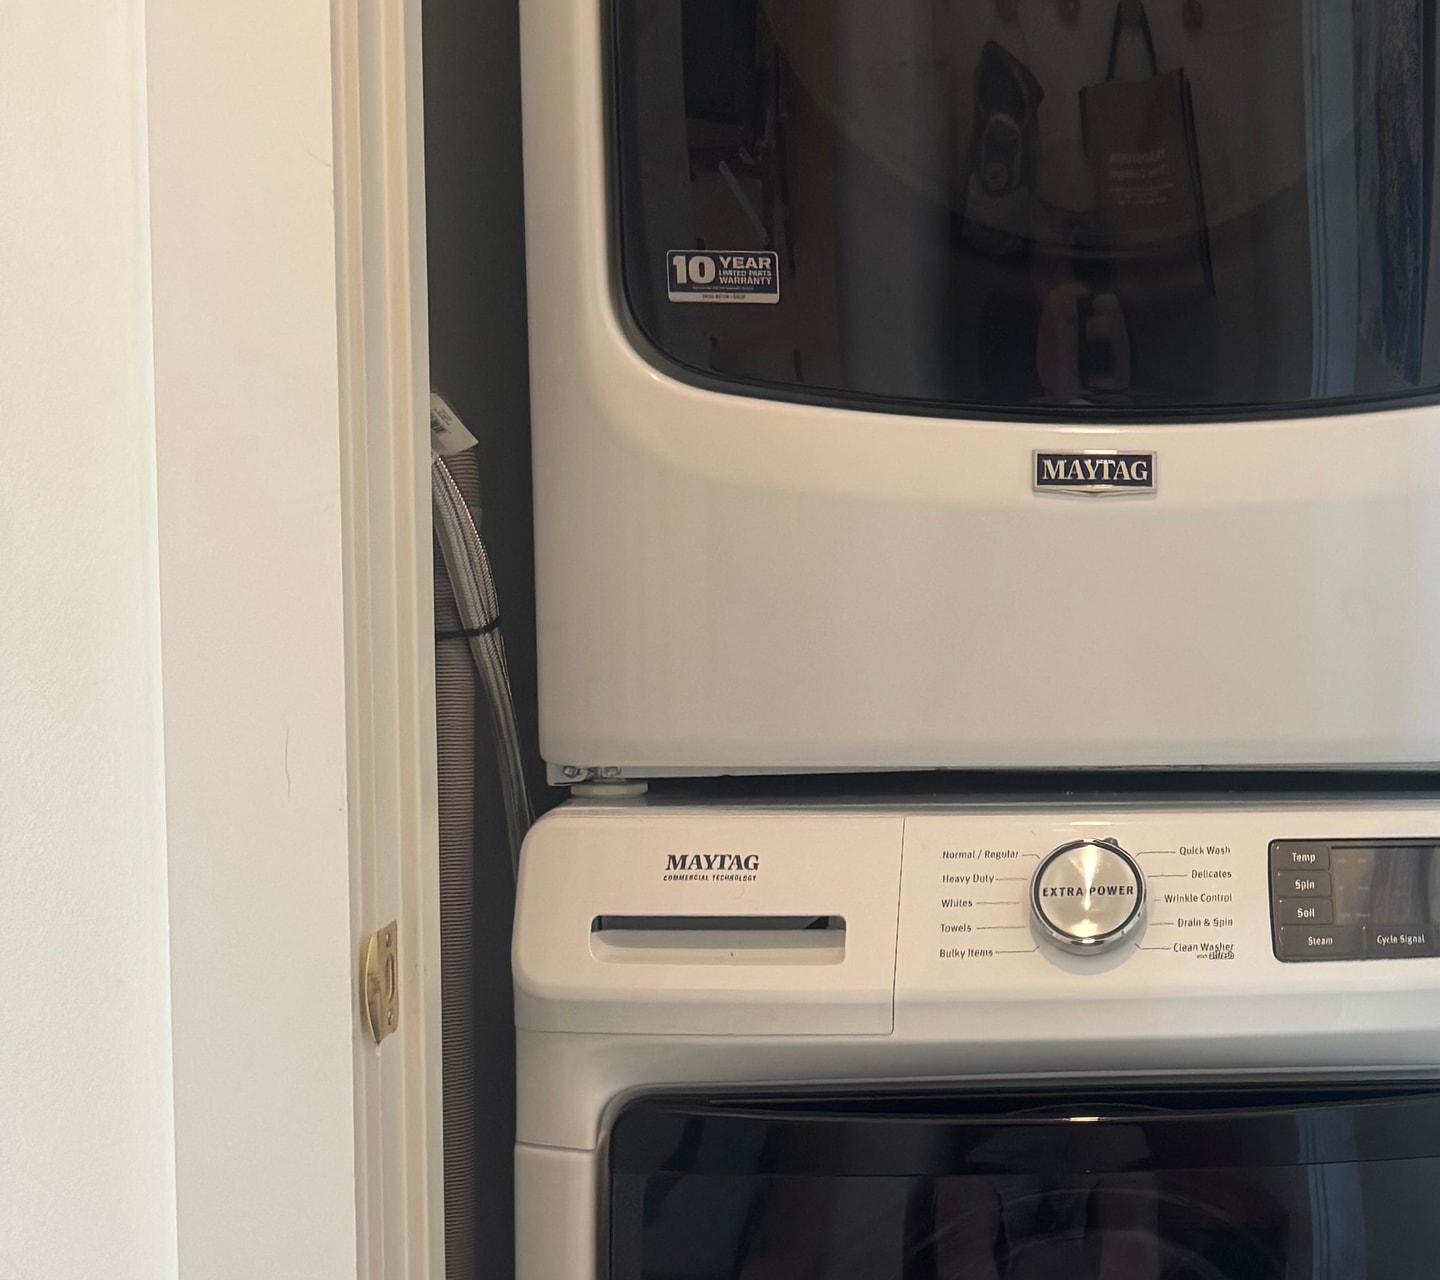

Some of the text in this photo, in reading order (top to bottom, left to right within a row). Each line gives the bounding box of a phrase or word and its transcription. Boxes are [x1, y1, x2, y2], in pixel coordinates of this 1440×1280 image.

[673, 255, 771, 284] 10 YEAR
[719, 276, 772, 285] WARRANTY
[1042, 459, 1149, 481] MAYTAG
[942, 849, 975, 860] Normal
[984, 849, 1019, 860] Regular
[1179, 845, 1231, 856] Quick Wash
[665, 853, 760, 871] MAYTAG
[1292, 852, 1316, 863] Temp
[663, 874, 757, 882] COMMERCIAL TECHNOLOGY
[942, 874, 995, 885] Heavy Duty
[1191, 869, 1232, 879] Delicates
[1295, 879, 1315, 891] Spin
[1042, 885, 1134, 897] EXTRA POWER
[941, 898, 973, 908] Whites
[1164, 893, 1232, 903] Wrinkle Control
[1297, 907, 1315, 918] Soil
[940, 923, 972, 933] Towels
[1177, 917, 1233, 928] Drain & Spin
[1308, 935, 1333, 945] Steam
[1377, 934, 1425, 946] Cycle Signal
[1173, 942, 1234, 953] Clean Washer
[939, 948, 993, 959] Bulky Items
